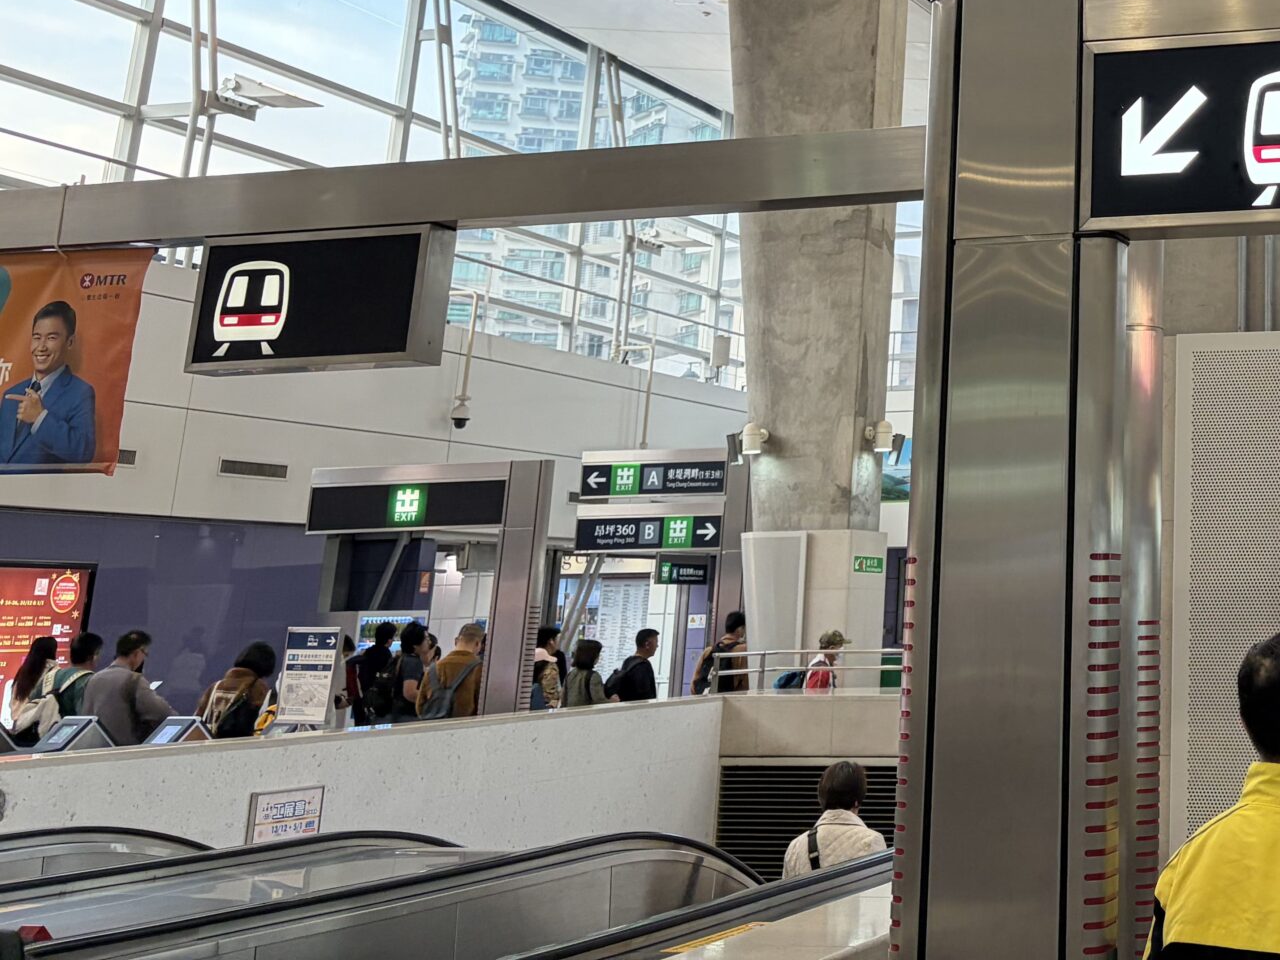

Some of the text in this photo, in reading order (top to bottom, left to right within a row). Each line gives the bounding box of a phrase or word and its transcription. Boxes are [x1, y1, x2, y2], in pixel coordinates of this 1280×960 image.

[95, 274, 127, 286] MTR
[616, 467, 635, 485] 出
[647, 471, 659, 486] A
[395, 489, 420, 512] 出
[394, 512, 418, 521] EXIT
[594, 524, 636, 536] 昂坪360
[645, 524, 655, 540] B
[669, 520, 688, 537] 出
[272, 800, 306, 819] 工展會
